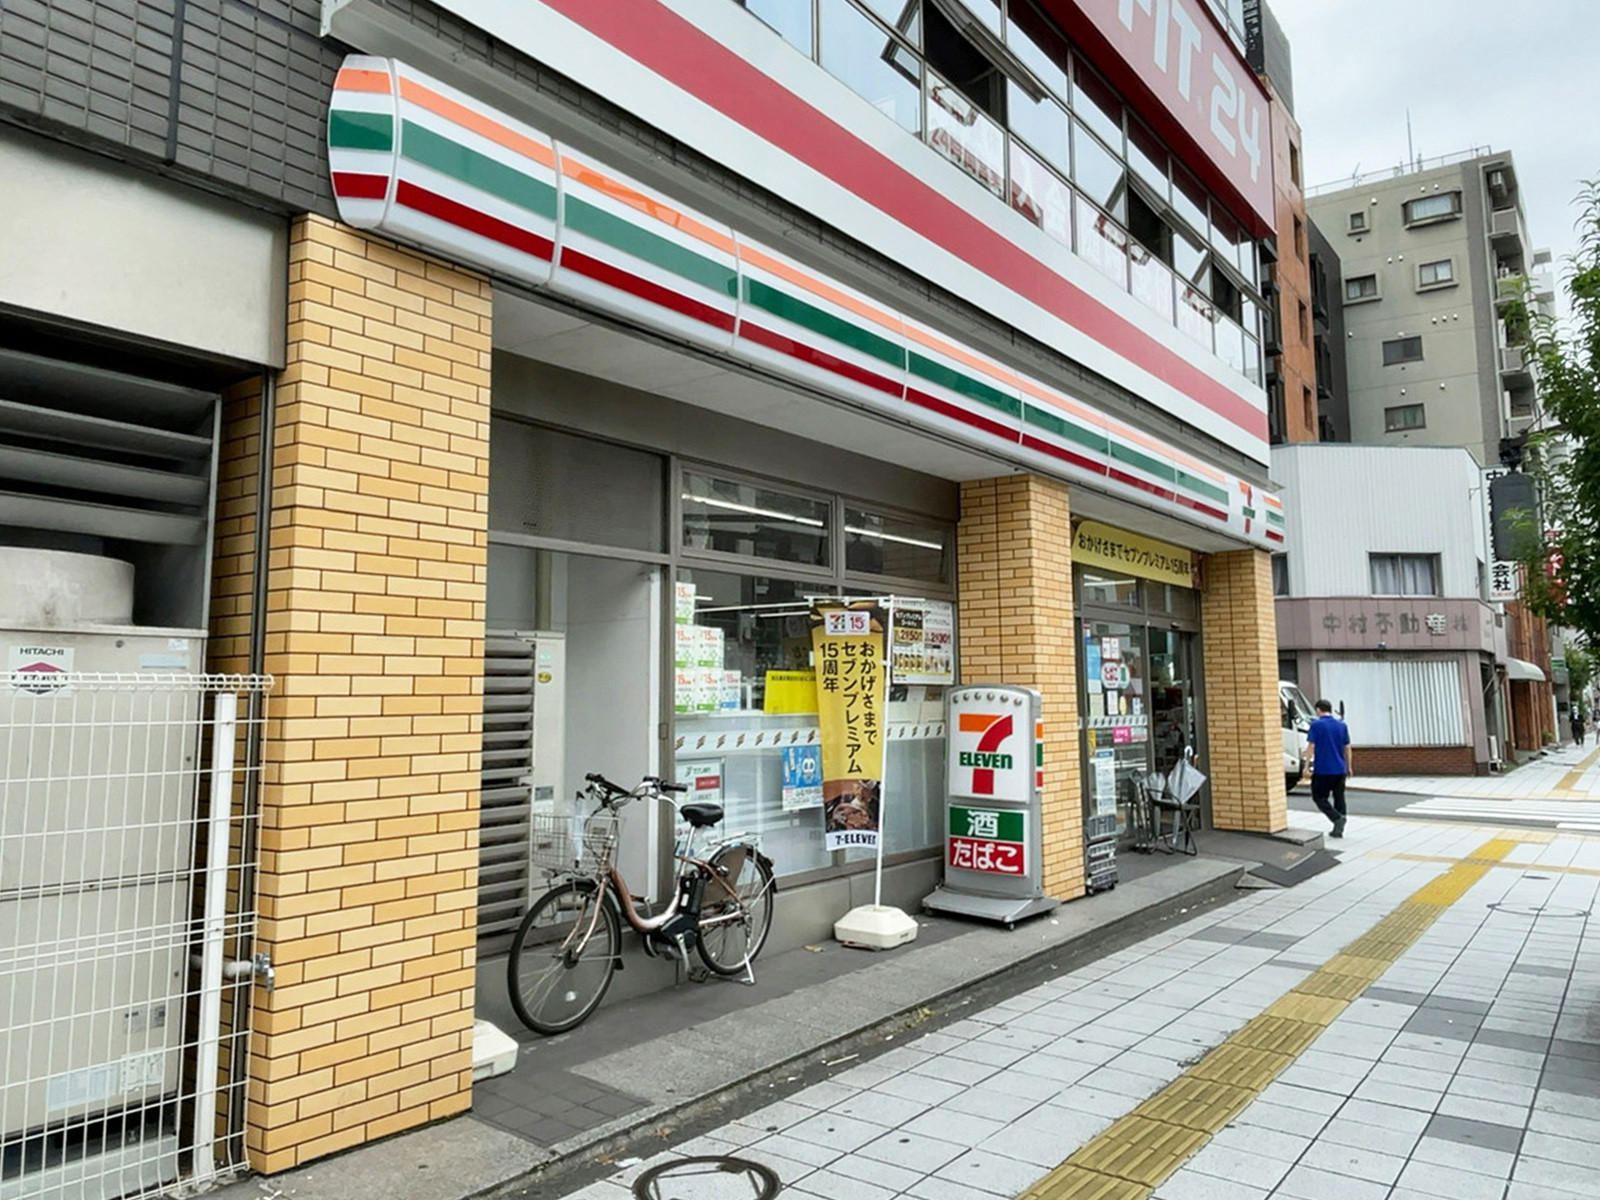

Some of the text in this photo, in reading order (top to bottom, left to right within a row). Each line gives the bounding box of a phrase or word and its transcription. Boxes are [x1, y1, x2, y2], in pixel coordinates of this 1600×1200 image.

[1210, 52, 1261, 184] 24
[19, 648, 65, 656] HITACHI
[820, 642, 839, 693] 15周年
[841, 641, 862, 773] セブンプレミアム
[860, 641, 878, 745] おかげさまで
[967, 810, 999, 838] 酒
[953, 840, 1019, 872] たばこ
